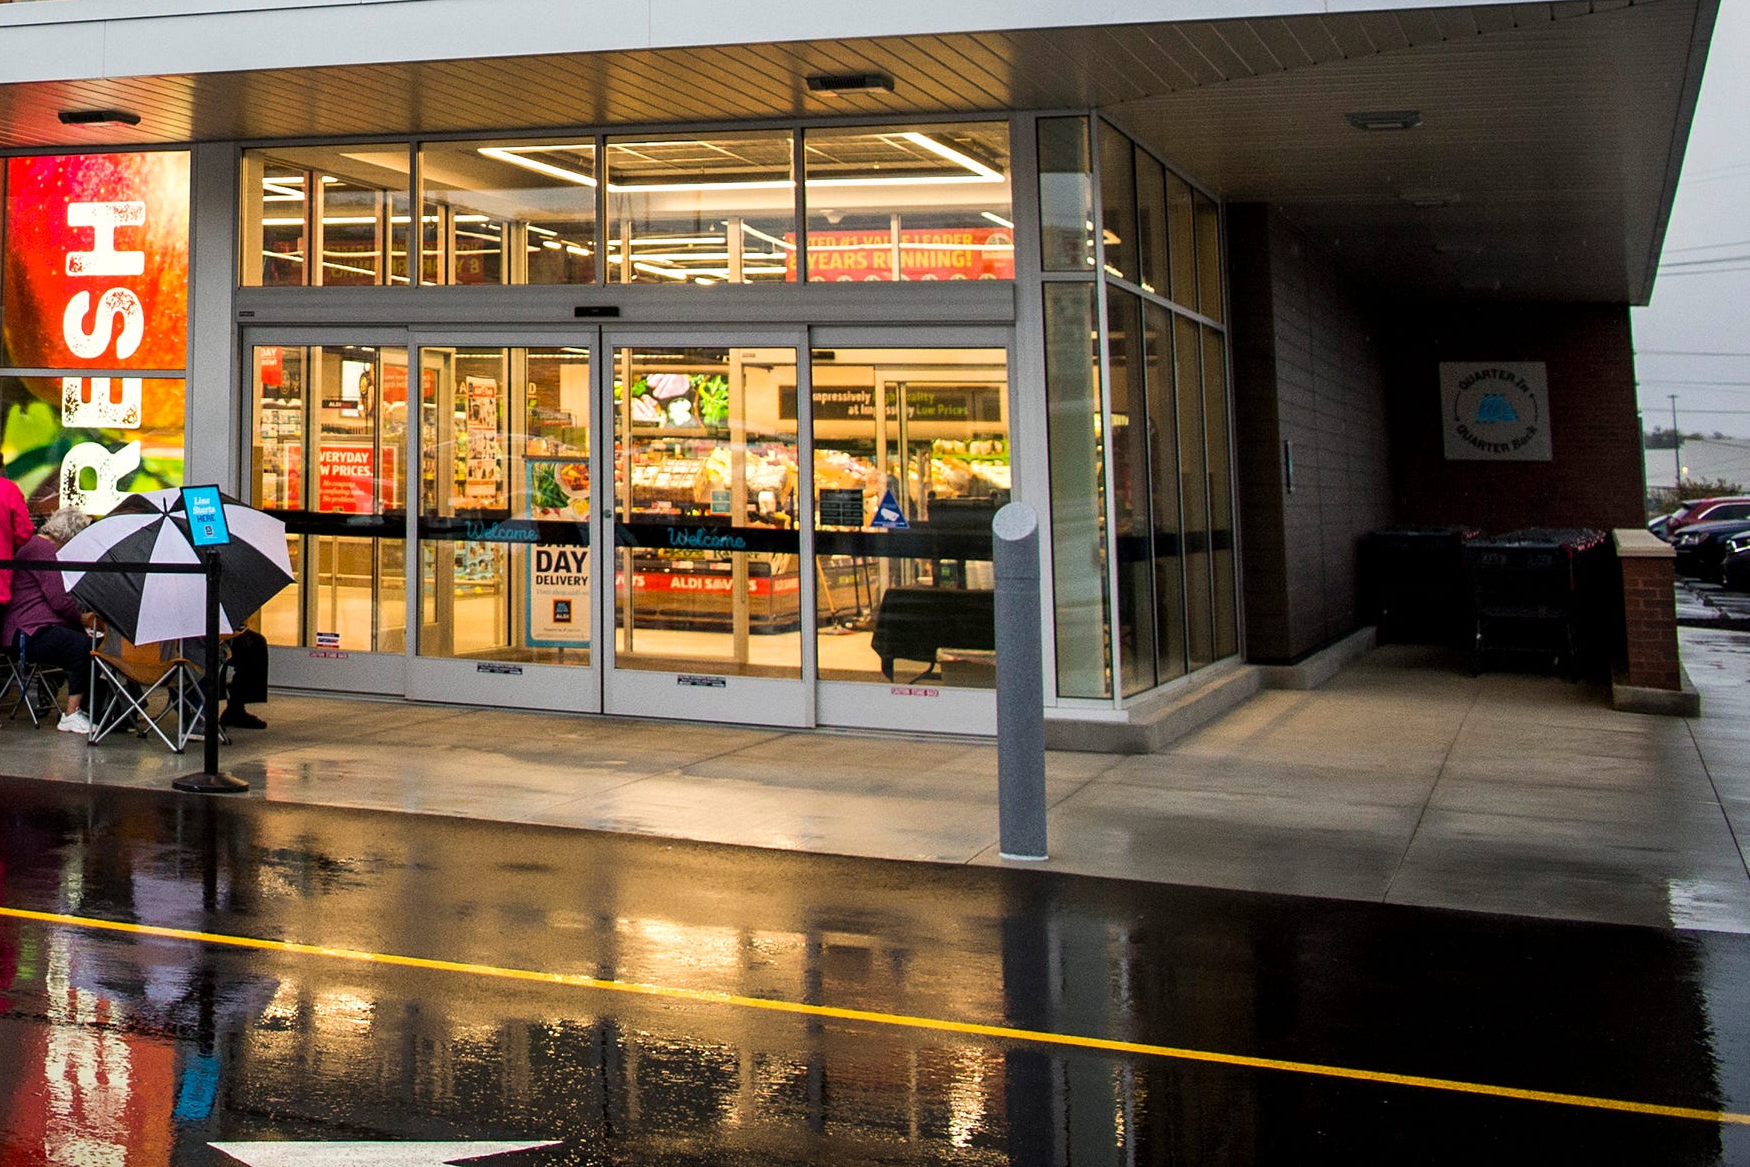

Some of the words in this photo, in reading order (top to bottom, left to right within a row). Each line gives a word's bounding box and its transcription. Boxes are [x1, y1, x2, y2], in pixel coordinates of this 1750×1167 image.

[862, 235, 910, 248] VALE
[913, 233, 974, 247] LEADER
[807, 251, 868, 270] YEARS
[878, 250, 973, 269] RNNING!
[59, 200, 146, 516] RESH
[1458, 369, 1516, 390] QUARTER
[813, 391, 872, 405] mpressively
[1456, 424, 1511, 453] QUARTER
[320, 451, 369, 463] VERYDAY
[332, 464, 374, 477] PRICES.
[197, 514, 215, 522] HERE
[464, 520, 539, 541] Welcome
[667, 527, 747, 549] Welcome
[536, 550, 588, 574] DAY
[535, 574, 589, 586] DELIVERY
[670, 576, 702, 589] ALDI
[704, 577, 758, 591] SAVS
